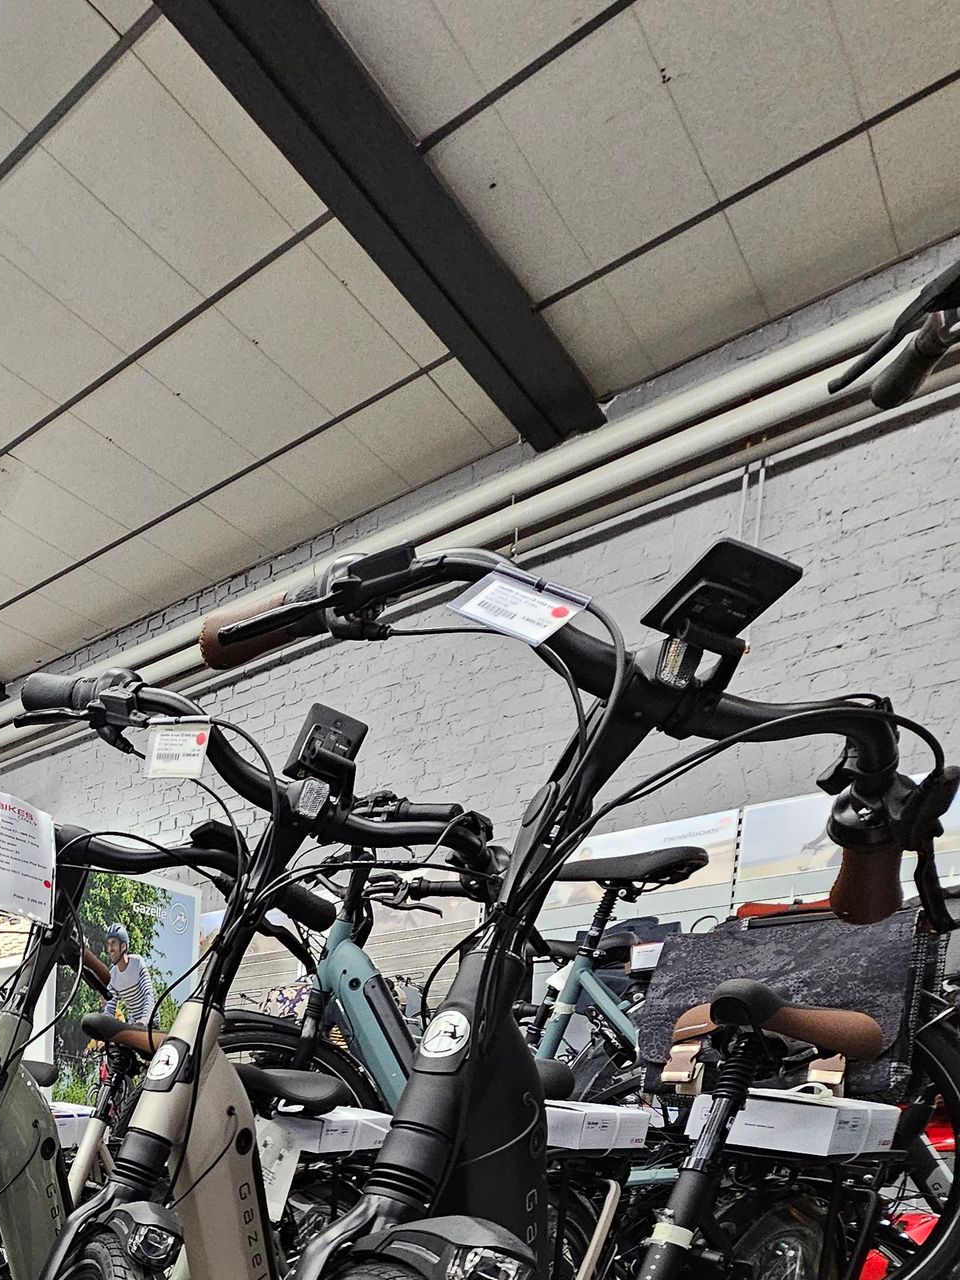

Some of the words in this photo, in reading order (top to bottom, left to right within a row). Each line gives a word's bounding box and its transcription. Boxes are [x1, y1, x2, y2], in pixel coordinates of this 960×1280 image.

[0, 802, 34, 821] BIKES
[17, 815, 38, 827] ONLY
[133, 902, 168, 920] Gazelle
